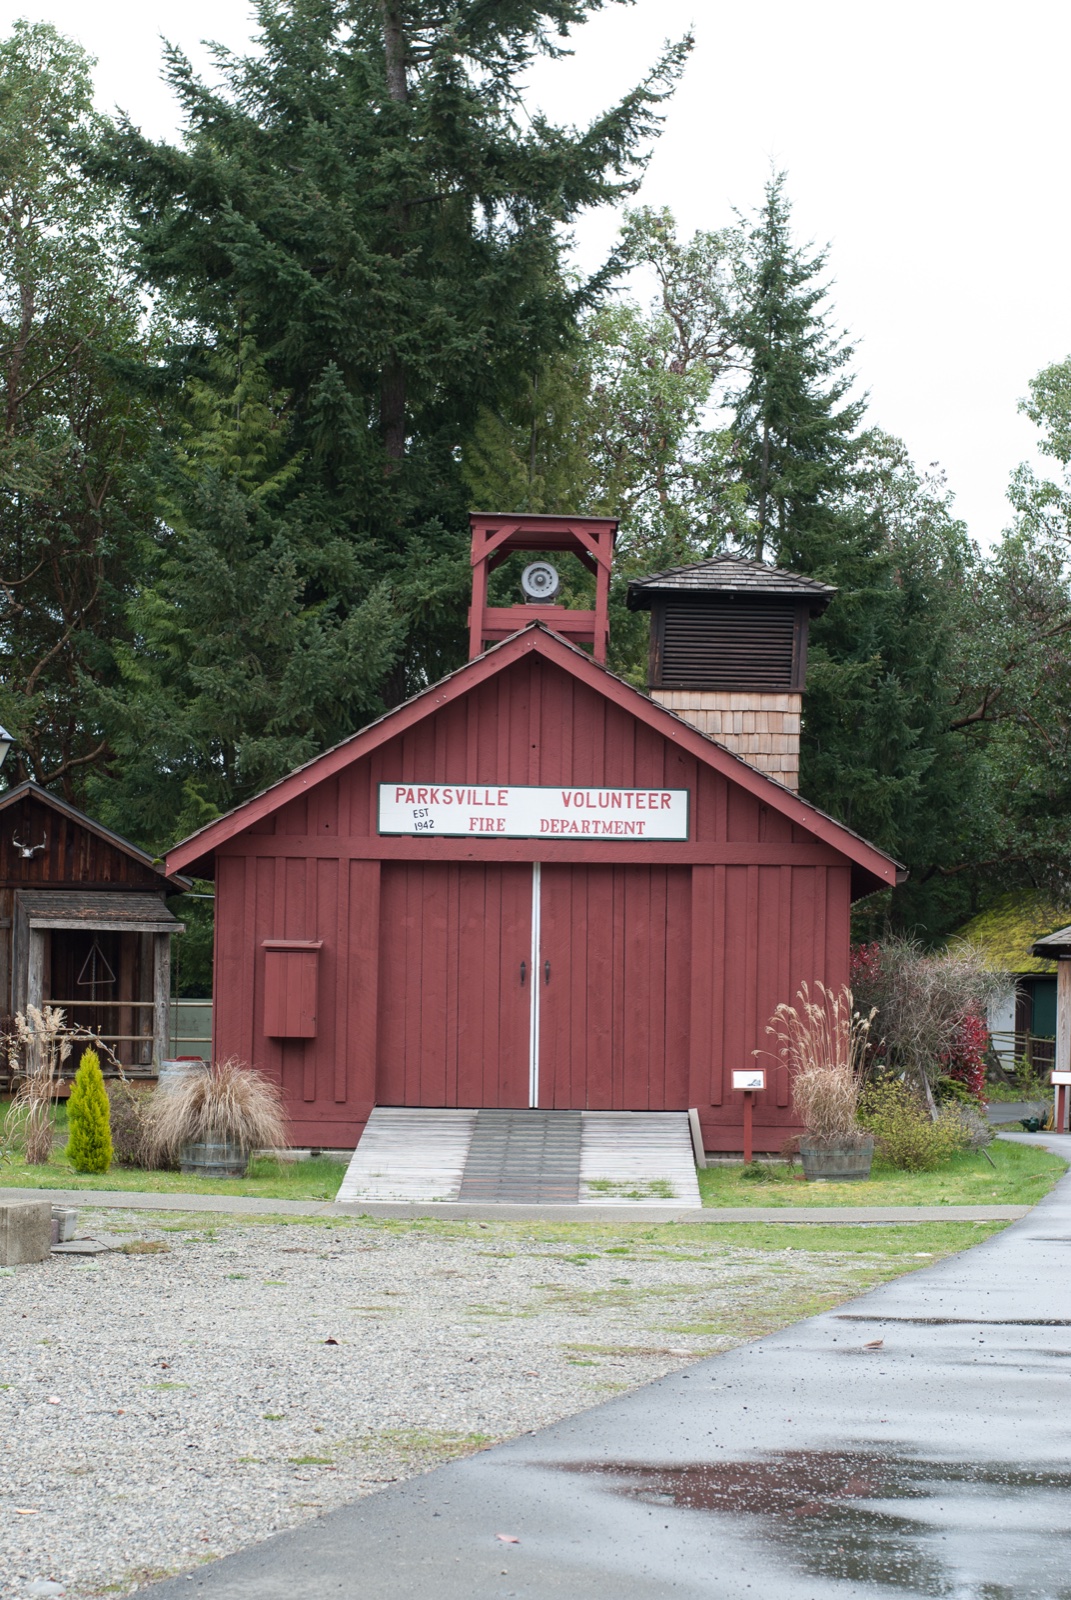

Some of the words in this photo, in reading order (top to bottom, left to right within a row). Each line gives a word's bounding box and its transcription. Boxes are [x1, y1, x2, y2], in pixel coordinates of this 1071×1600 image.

[395, 787, 509, 806] PARKSVILLE
[561, 791, 672, 810] VOLUNTEER
[413, 808, 429, 819] EST
[414, 819, 435, 831] 1942
[469, 817, 506, 832] FIRE
[540, 818, 646, 835] DEPARTMENT
